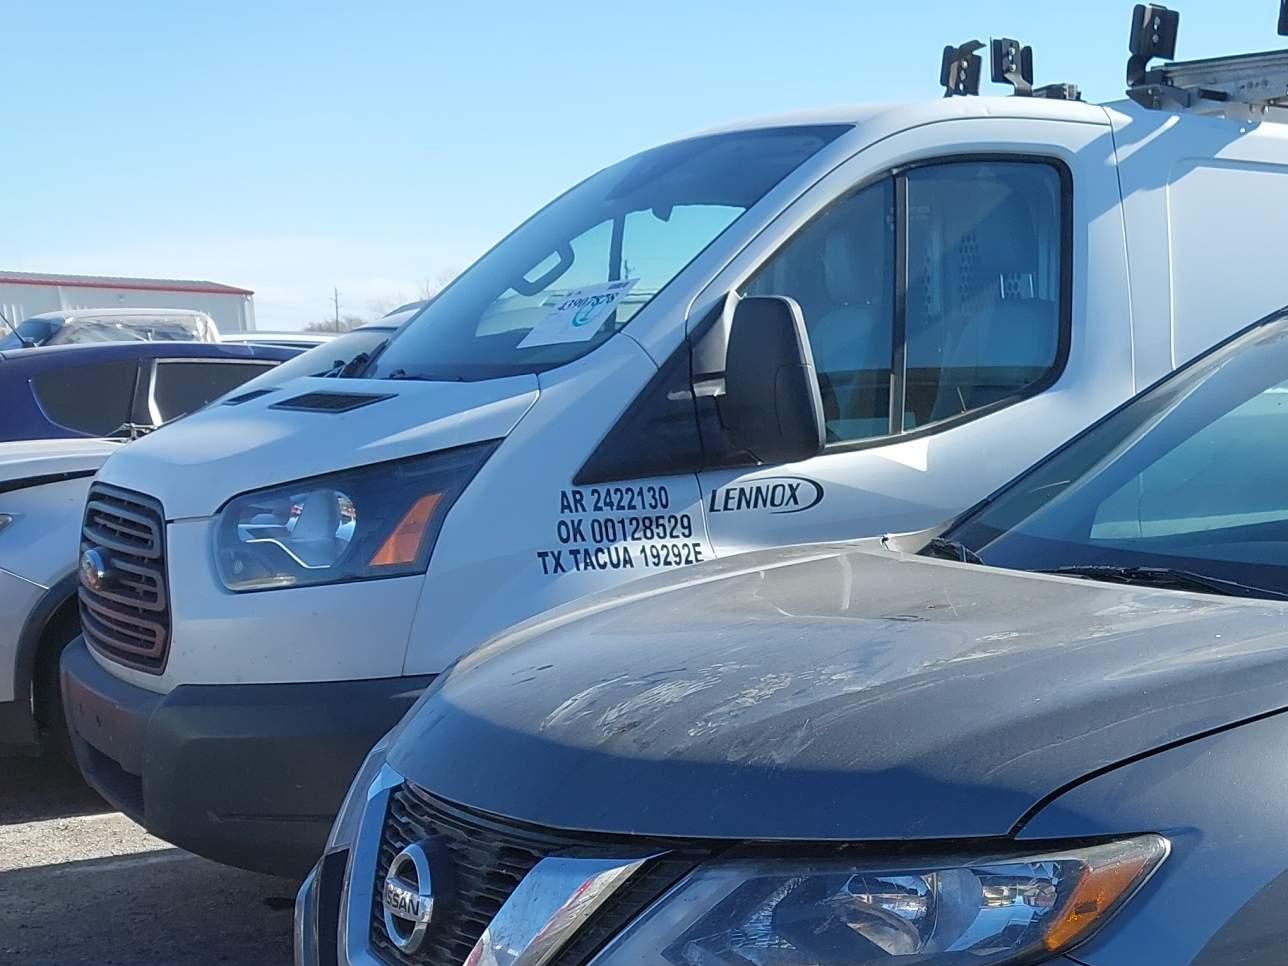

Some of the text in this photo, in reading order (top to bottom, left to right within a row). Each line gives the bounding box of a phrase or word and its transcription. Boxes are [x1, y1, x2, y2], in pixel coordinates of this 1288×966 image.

[560, 486, 669, 514] AR 2422130
[709, 484, 801, 512] LENNOX
[557, 514, 693, 544] OK 00128529
[537, 542, 704, 575] TX TACUA 19292E
[386, 889, 420, 916] SSAN
